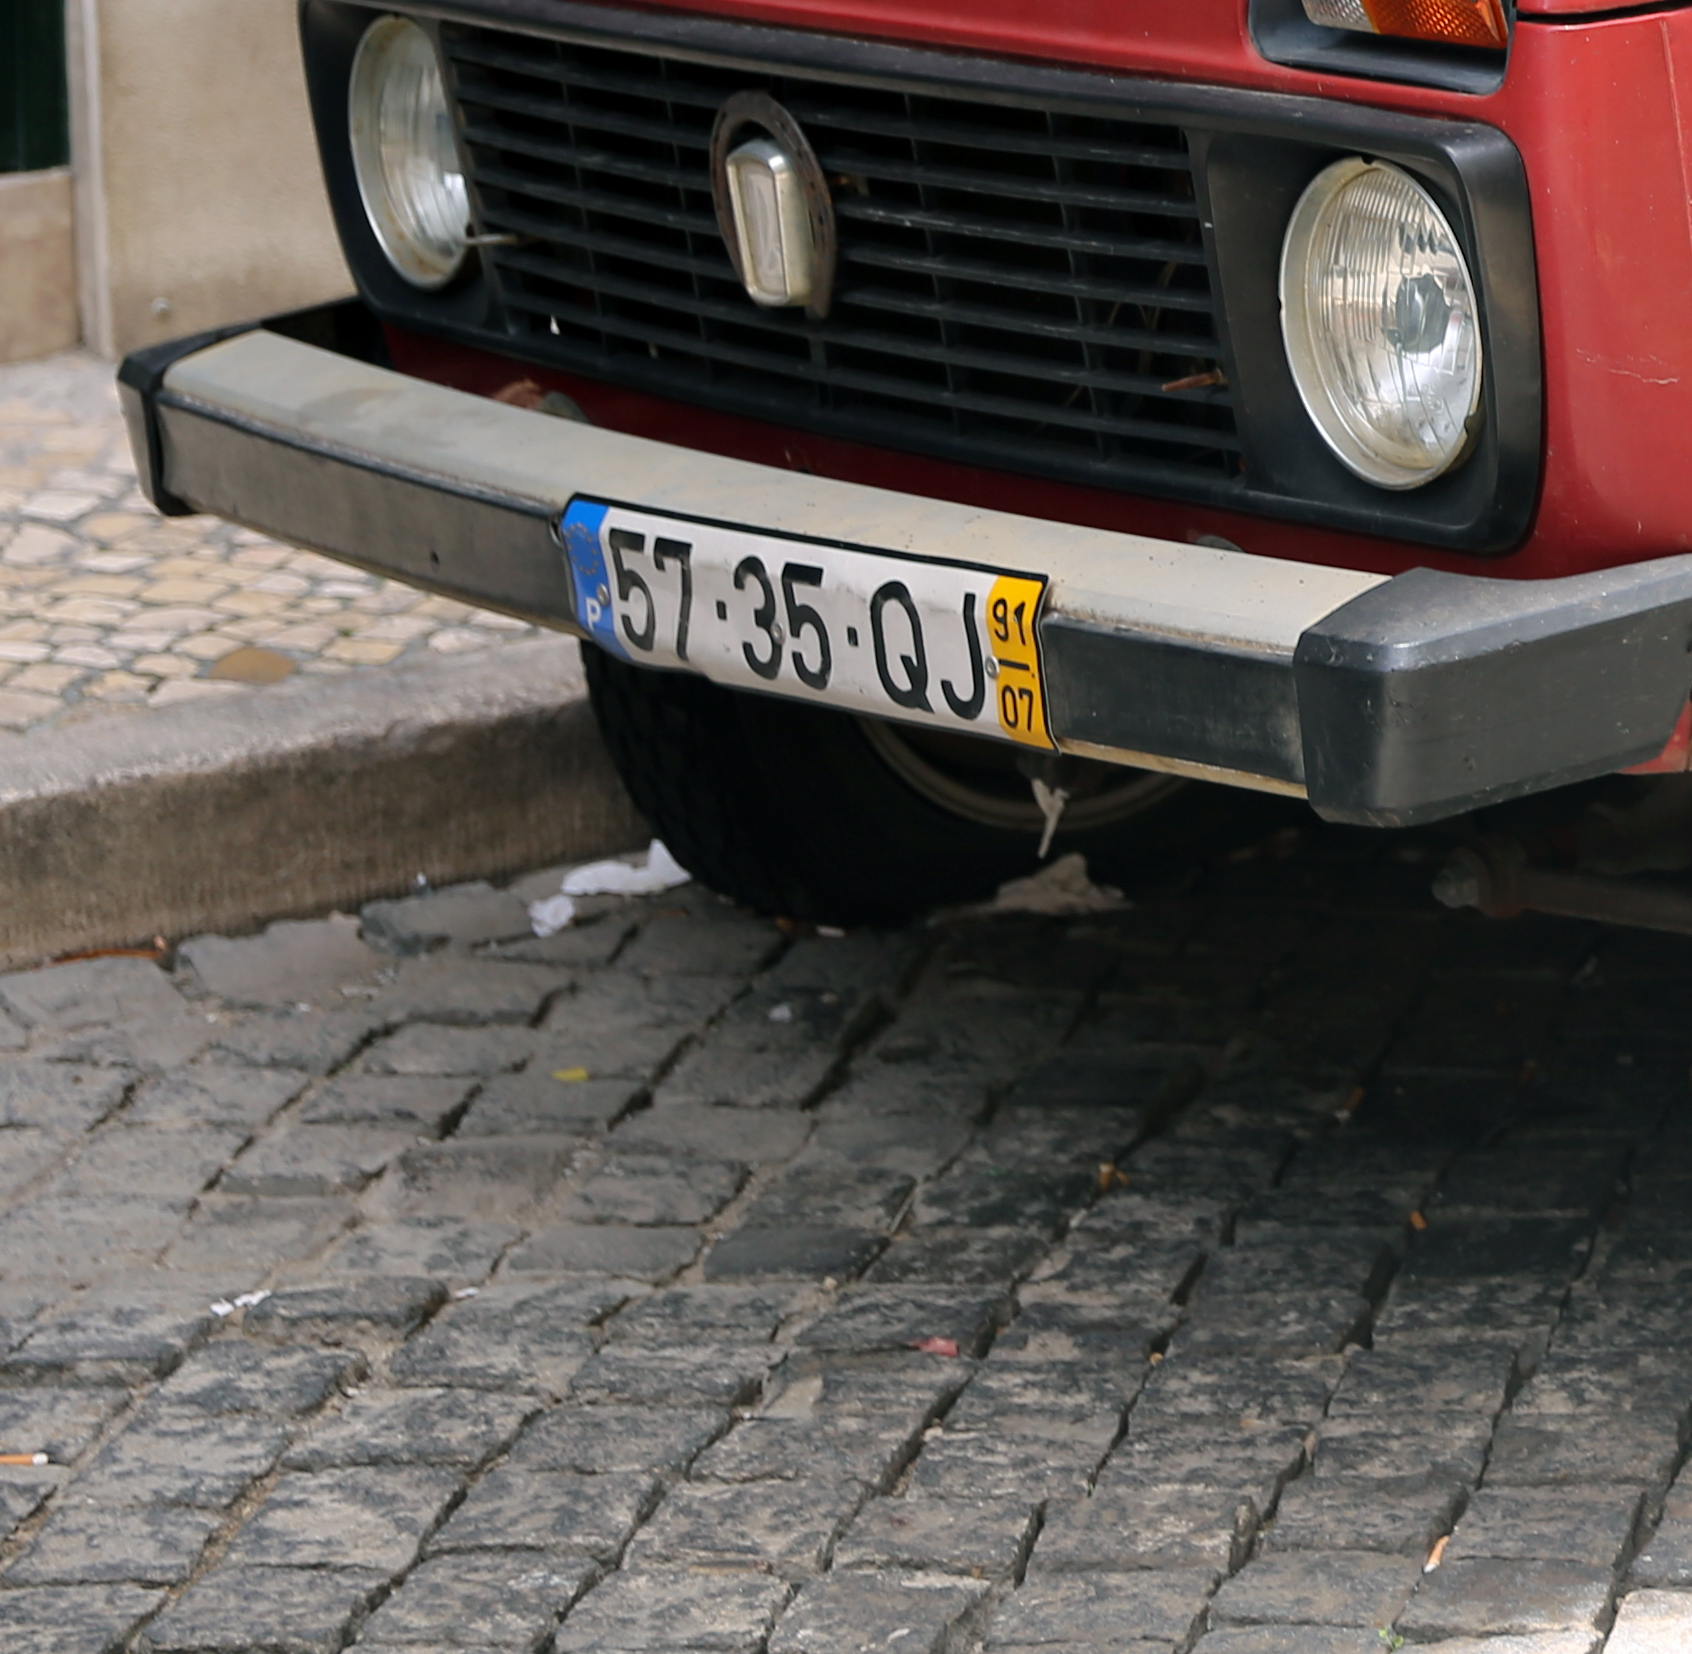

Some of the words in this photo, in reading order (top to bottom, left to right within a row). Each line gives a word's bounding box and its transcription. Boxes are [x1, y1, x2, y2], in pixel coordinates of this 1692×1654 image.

[586, 601, 602, 631] P
[991, 597, 1028, 646] 91
[1000, 684, 1035, 733] 07
